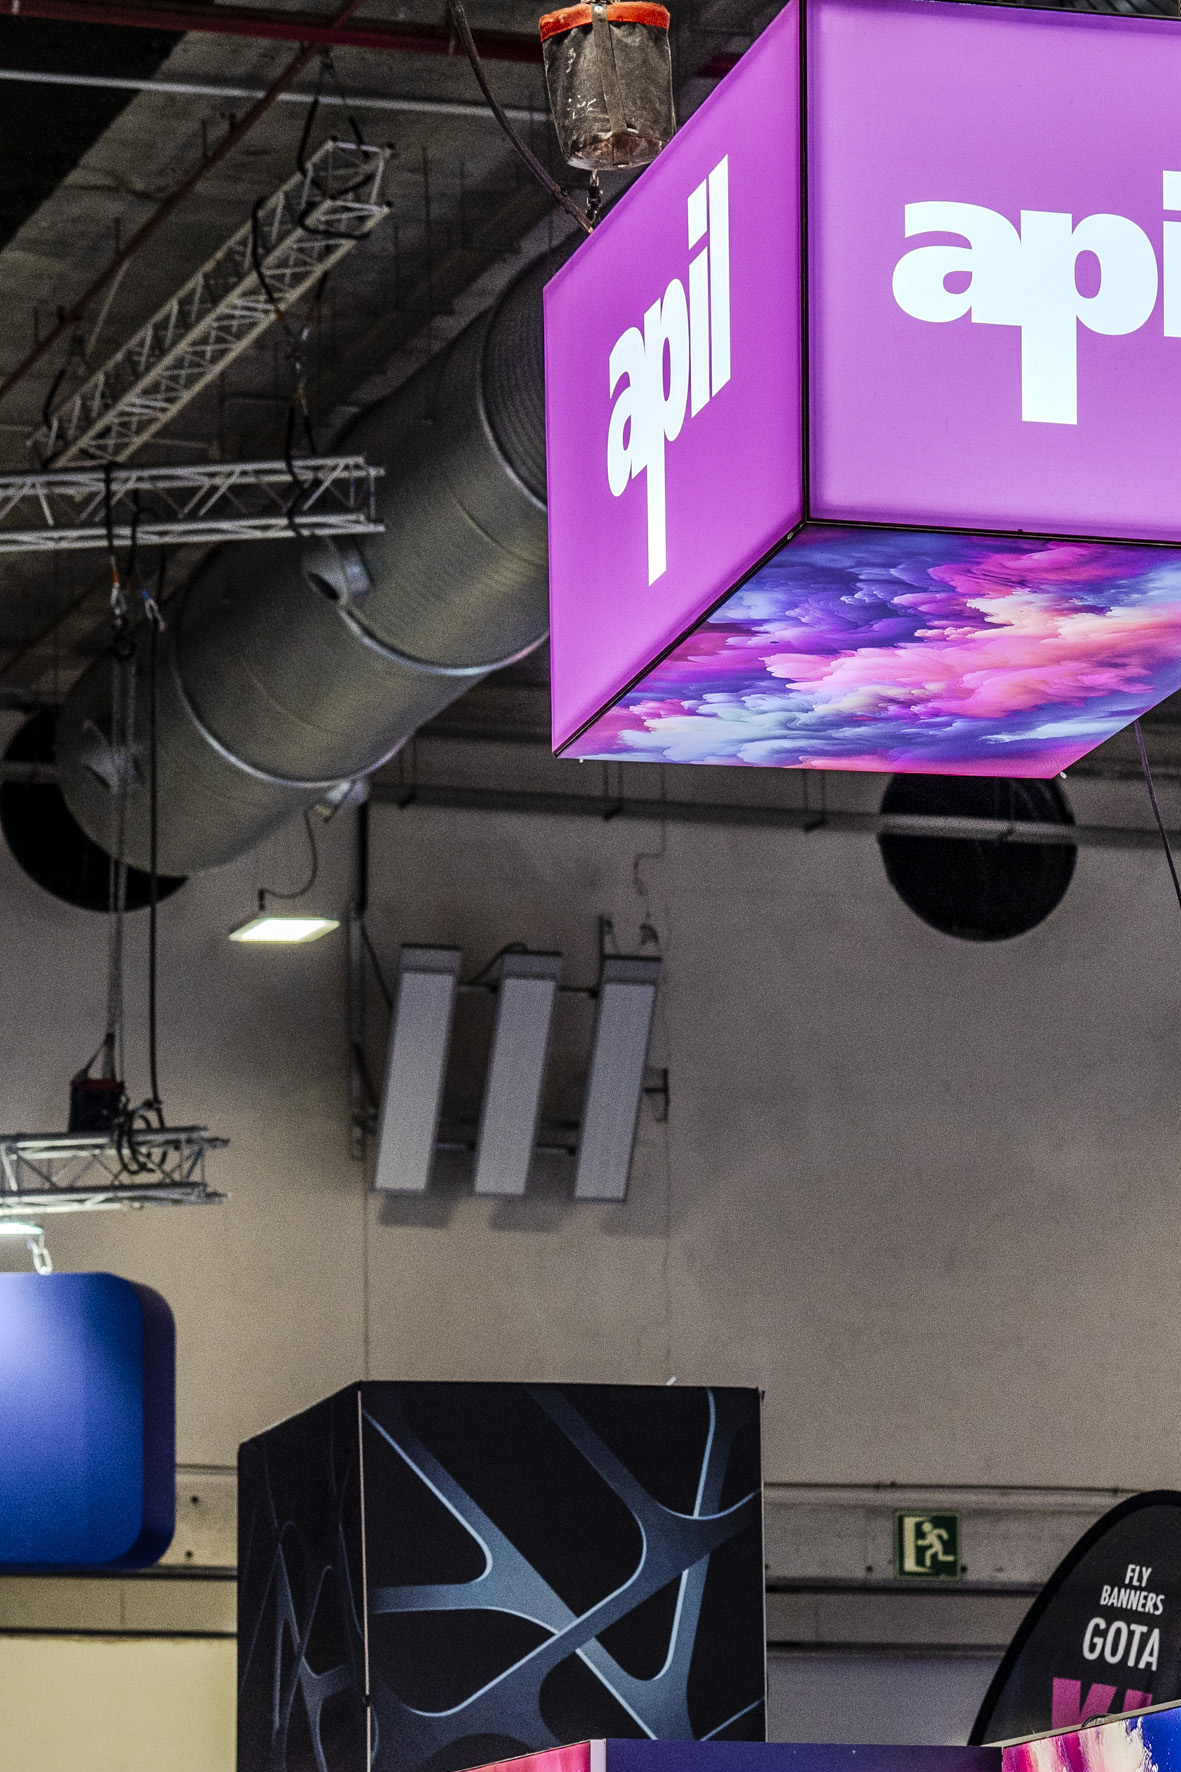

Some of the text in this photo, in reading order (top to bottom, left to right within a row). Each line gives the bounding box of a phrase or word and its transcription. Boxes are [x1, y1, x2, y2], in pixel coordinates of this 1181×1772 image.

[607, 154, 731, 587] apil
[1124, 1563, 1152, 1588] FLY
[1099, 1584, 1166, 1616] BANNERS
[1082, 1616, 1161, 1672] GOTA
